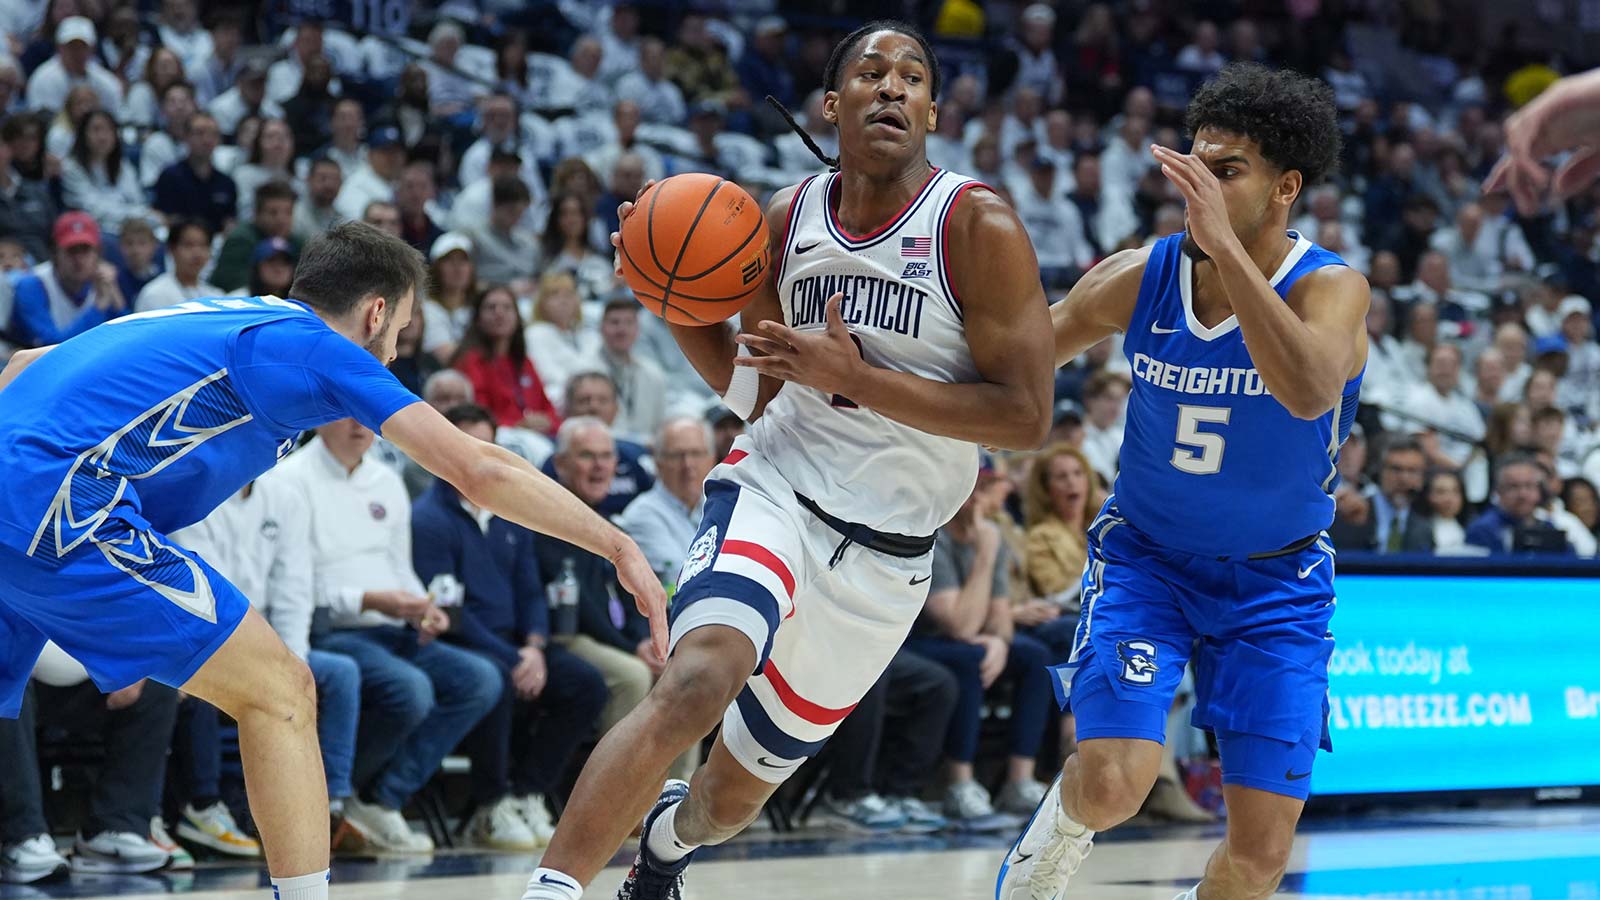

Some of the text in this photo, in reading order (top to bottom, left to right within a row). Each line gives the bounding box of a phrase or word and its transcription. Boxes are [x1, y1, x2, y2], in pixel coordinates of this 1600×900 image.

[901, 269, 933, 278] EAST
[905, 262, 928, 270] BIG
[1133, 352, 1272, 396] CREIGHTO
[1169, 403, 1232, 475] 5
[1330, 640, 1472, 684] ook today at
[1331, 692, 1532, 729] LYBREEZE.COM
